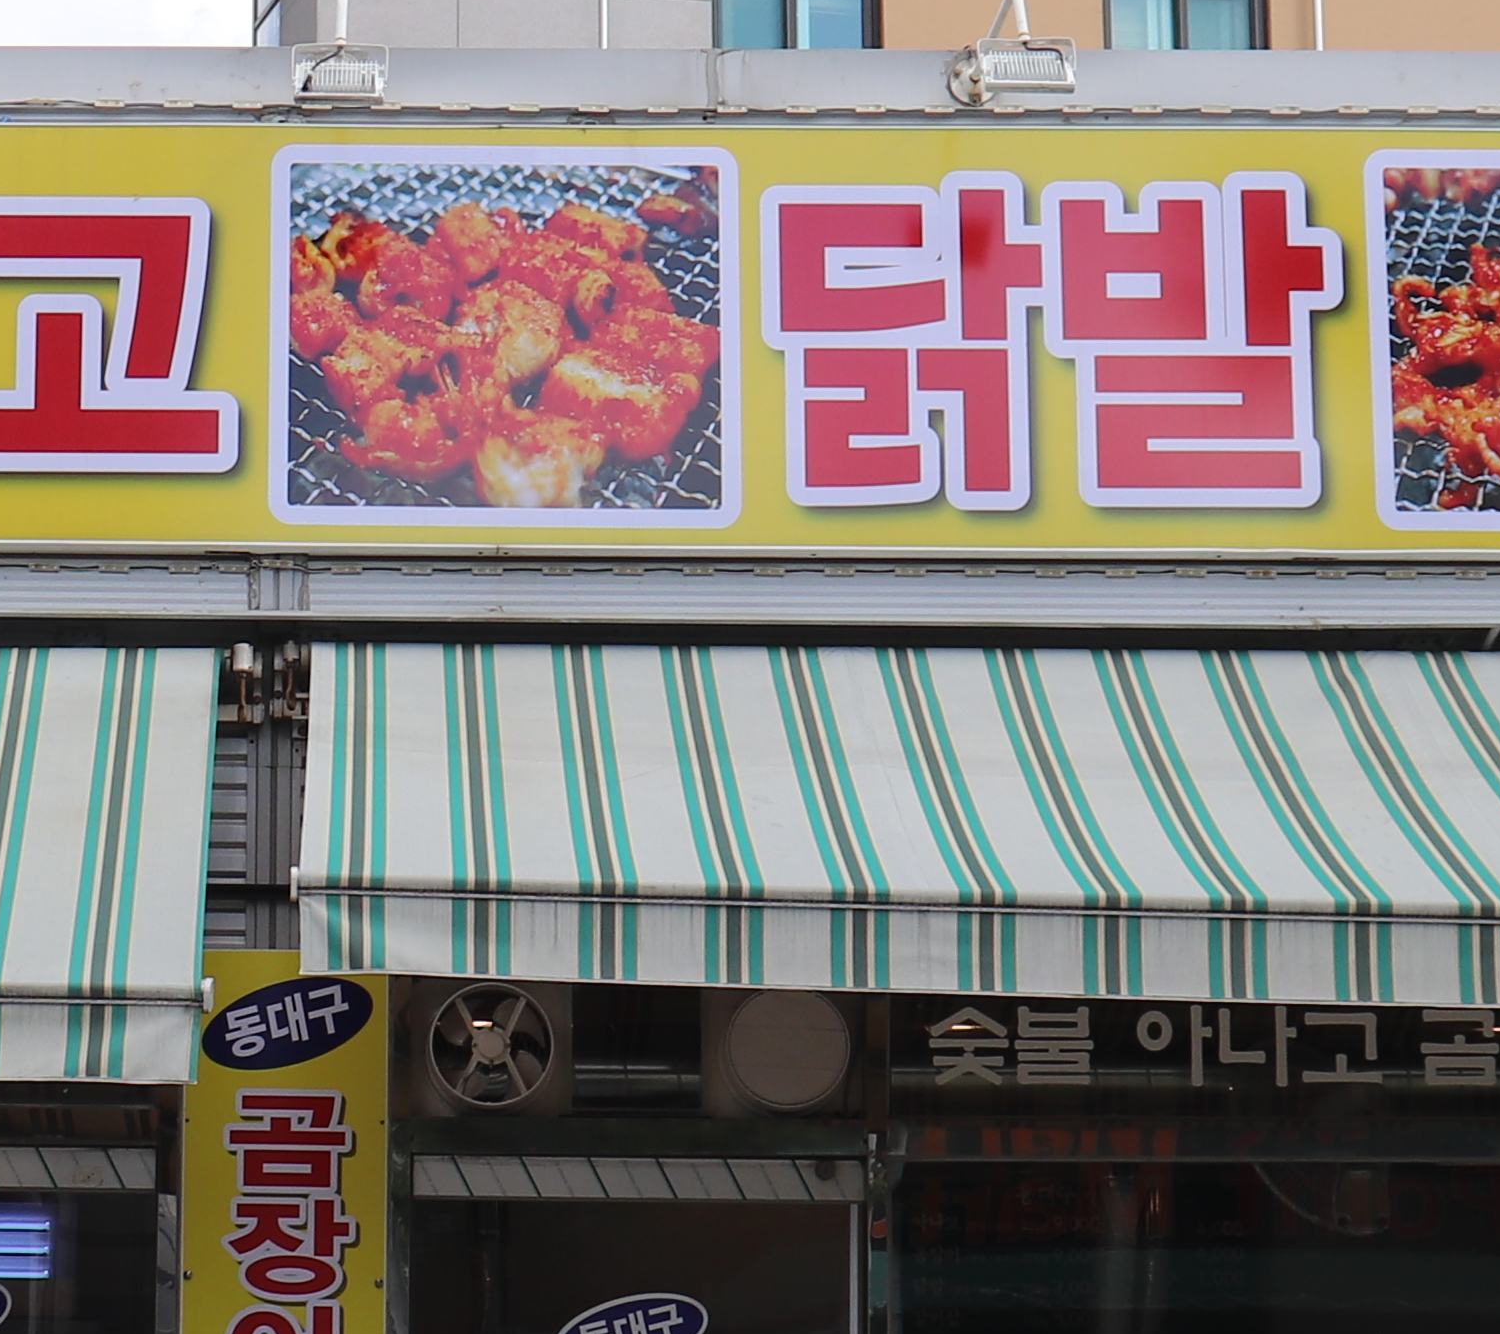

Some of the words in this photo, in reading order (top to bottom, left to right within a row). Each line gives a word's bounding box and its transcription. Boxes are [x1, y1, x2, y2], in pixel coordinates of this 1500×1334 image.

[759, 169, 1343, 511] 닭발
[224, 984, 350, 1058] 동대구
[927, 1005, 1095, 1088] 숯불
[1136, 1005, 1384, 1089] 아나고
